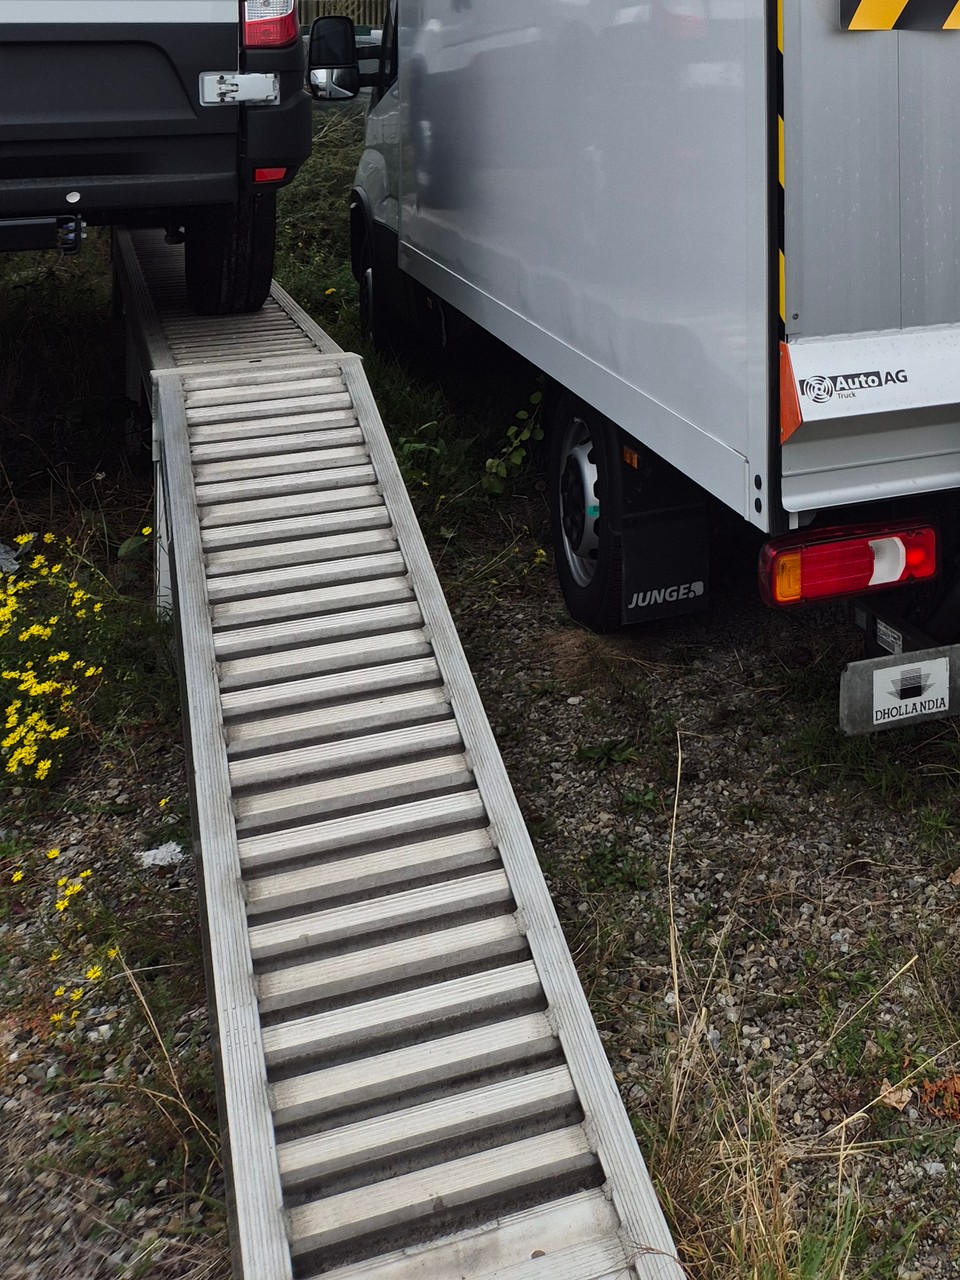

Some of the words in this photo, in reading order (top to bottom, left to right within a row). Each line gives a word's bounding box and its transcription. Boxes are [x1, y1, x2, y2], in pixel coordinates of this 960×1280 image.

[835, 373, 880, 391] Auto
[883, 369, 908, 385] AG
[837, 391, 857, 400] Truck
[627, 583, 690, 609] JUNGE
[874, 697, 947, 722] DHOLLANDIA
